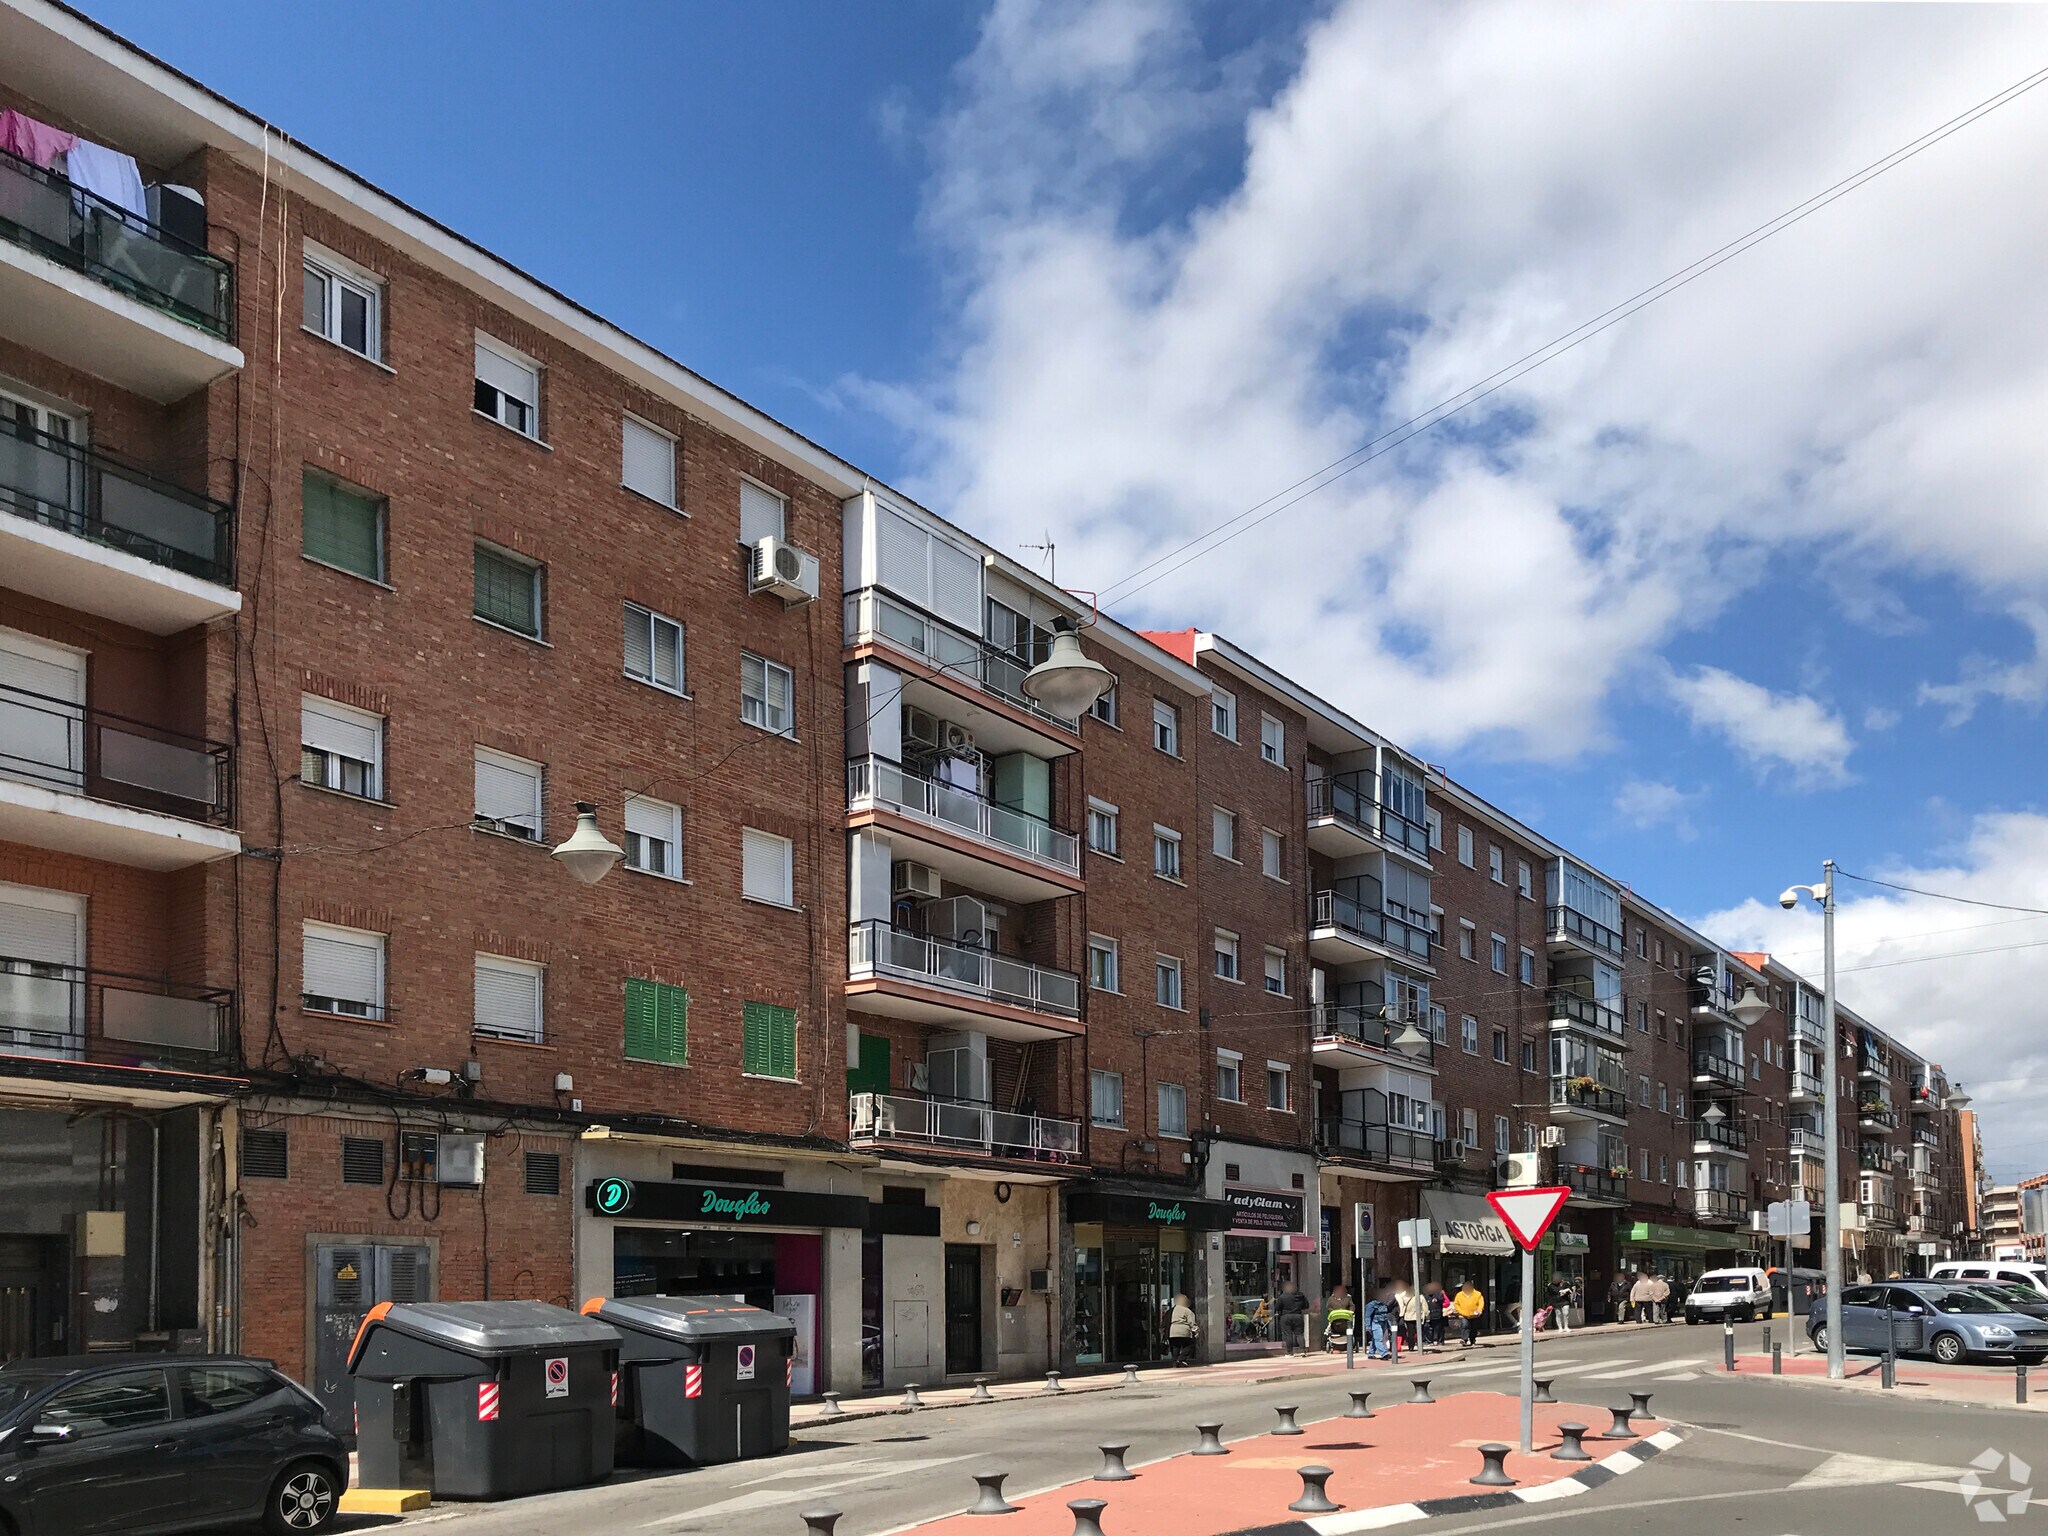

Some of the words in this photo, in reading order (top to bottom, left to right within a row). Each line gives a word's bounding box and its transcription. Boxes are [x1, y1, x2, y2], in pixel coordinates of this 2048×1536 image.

[605, 1184, 622, 1207] D
[701, 1190, 771, 1221] Douglas
[1148, 1202, 1187, 1225] Douglas
[1445, 1221, 1506, 1243] ASTORGA
